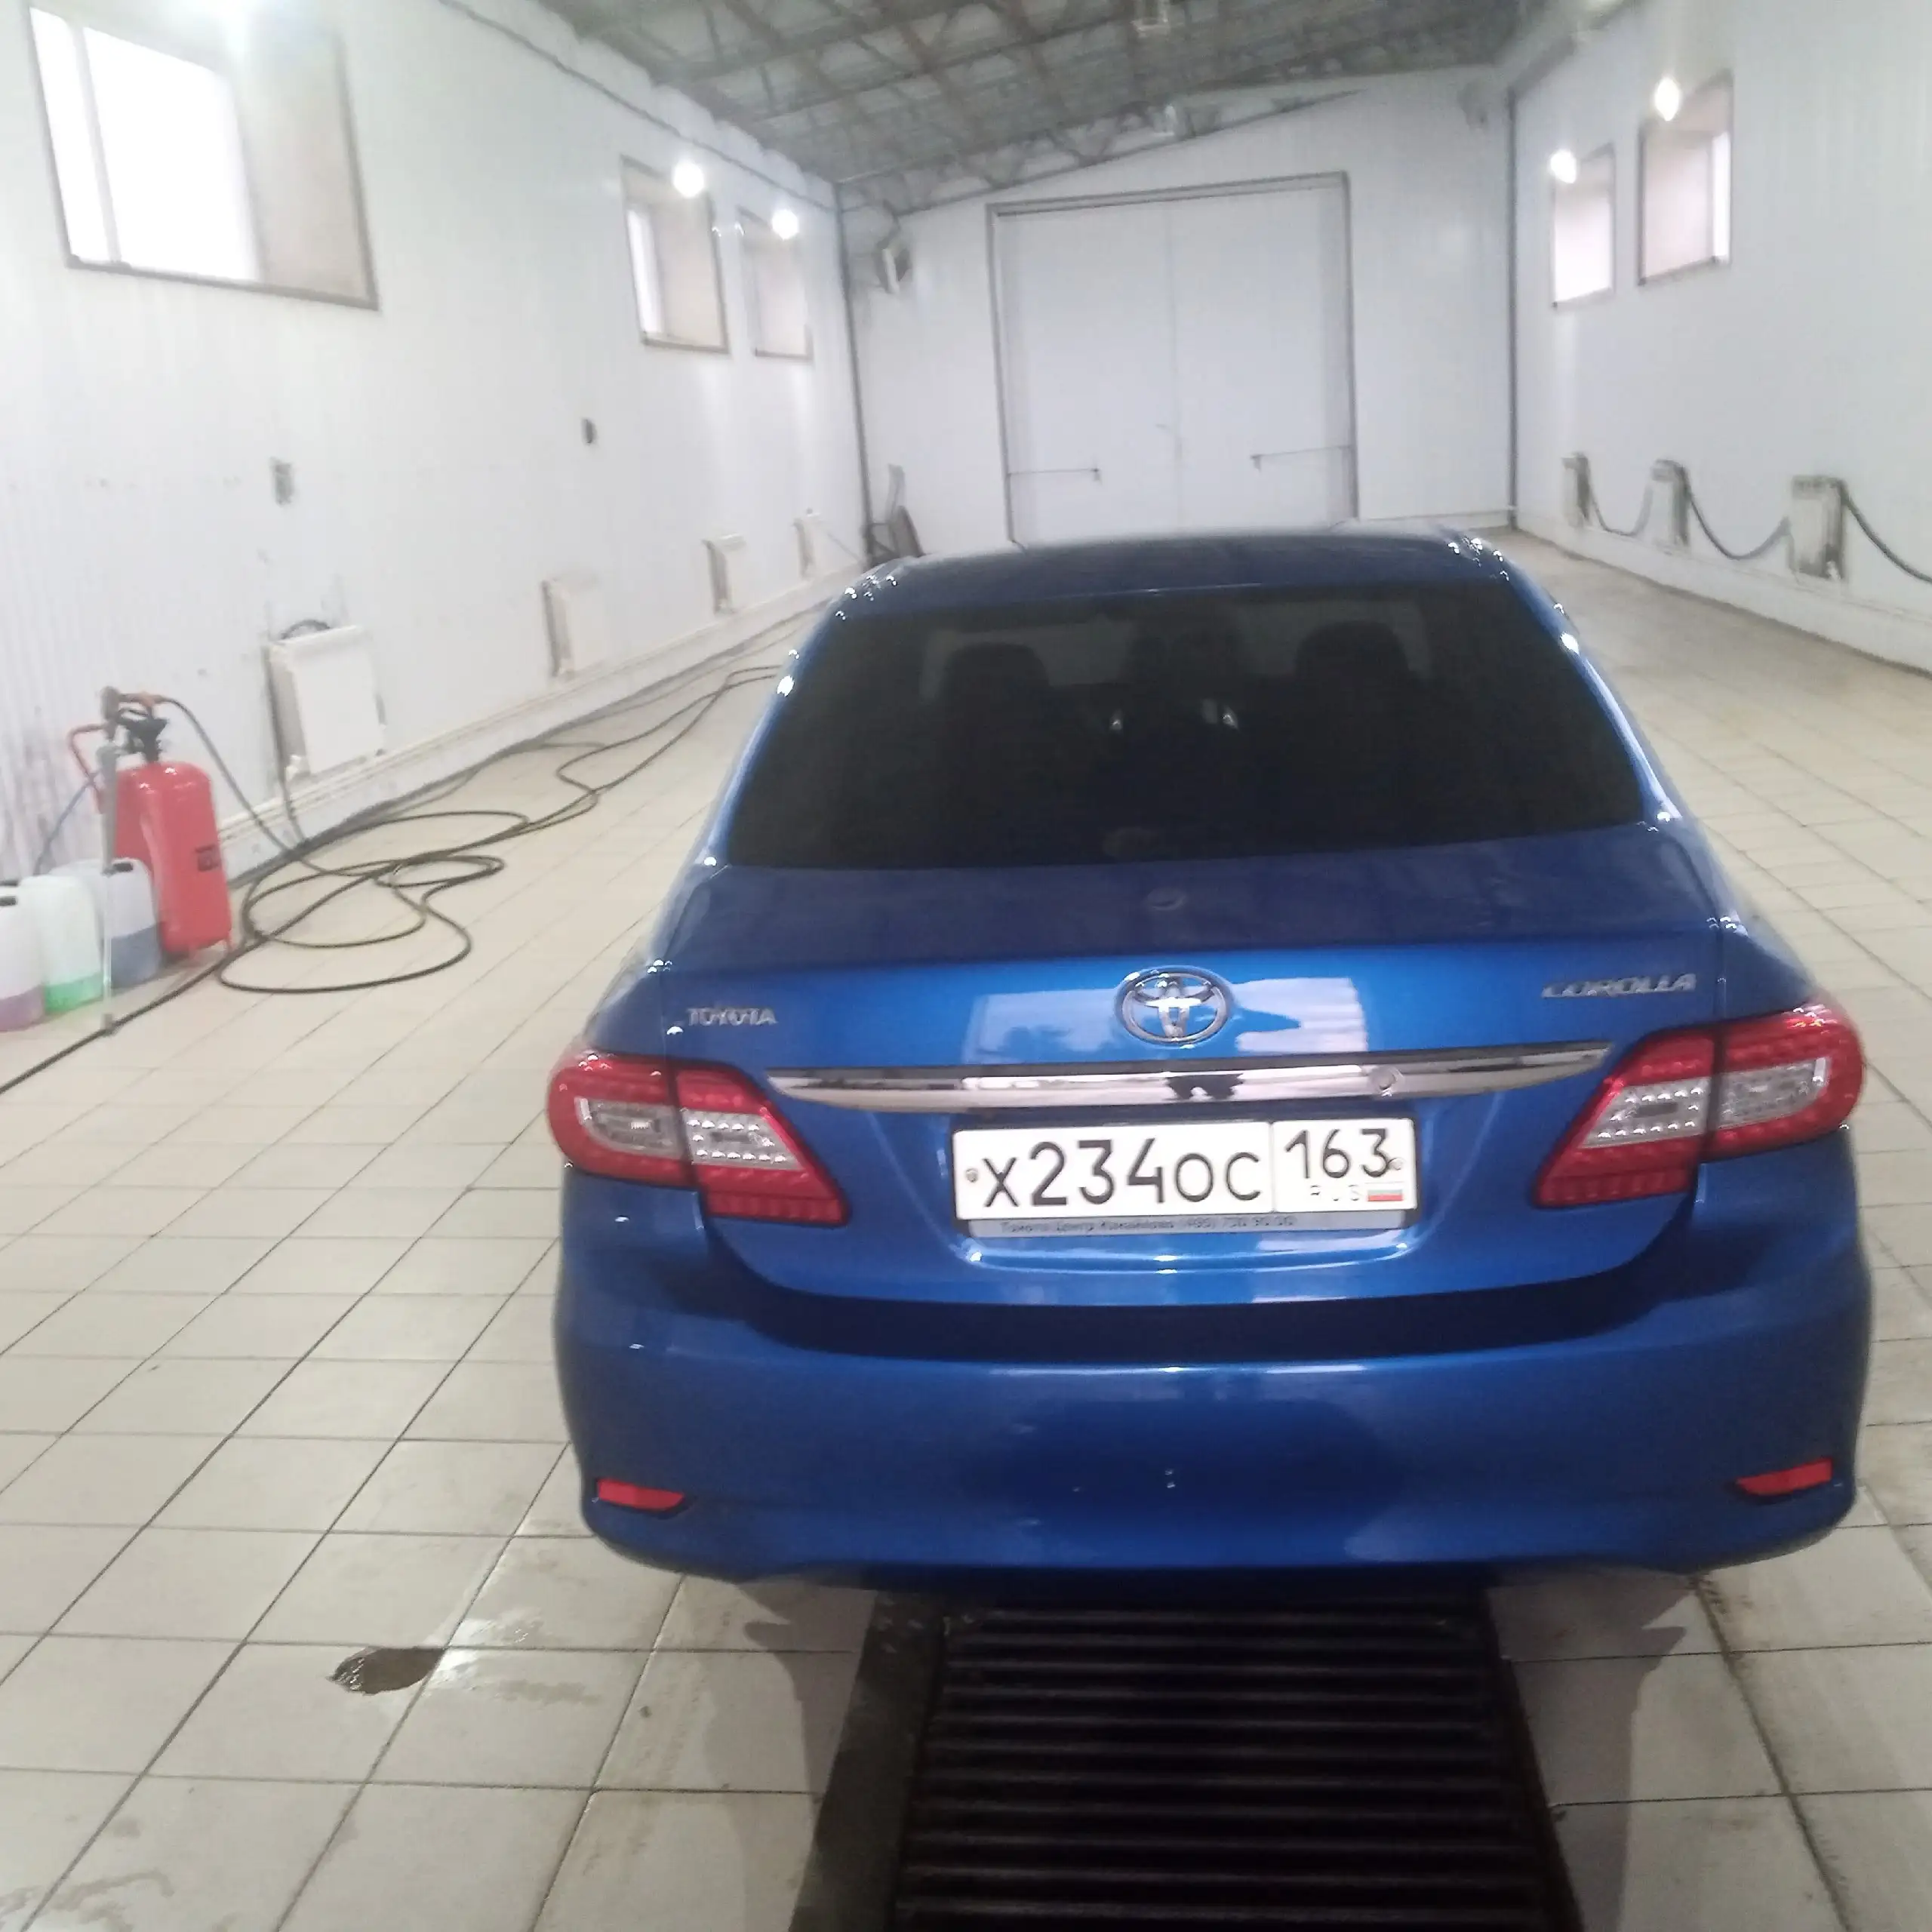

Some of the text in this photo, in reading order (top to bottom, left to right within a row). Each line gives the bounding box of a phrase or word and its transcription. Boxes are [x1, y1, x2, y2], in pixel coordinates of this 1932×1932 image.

[1541, 972, 1697, 998] COROLLA
[687, 1007, 777, 1026] TOYOTA
[1284, 1128, 1390, 1178] 163
